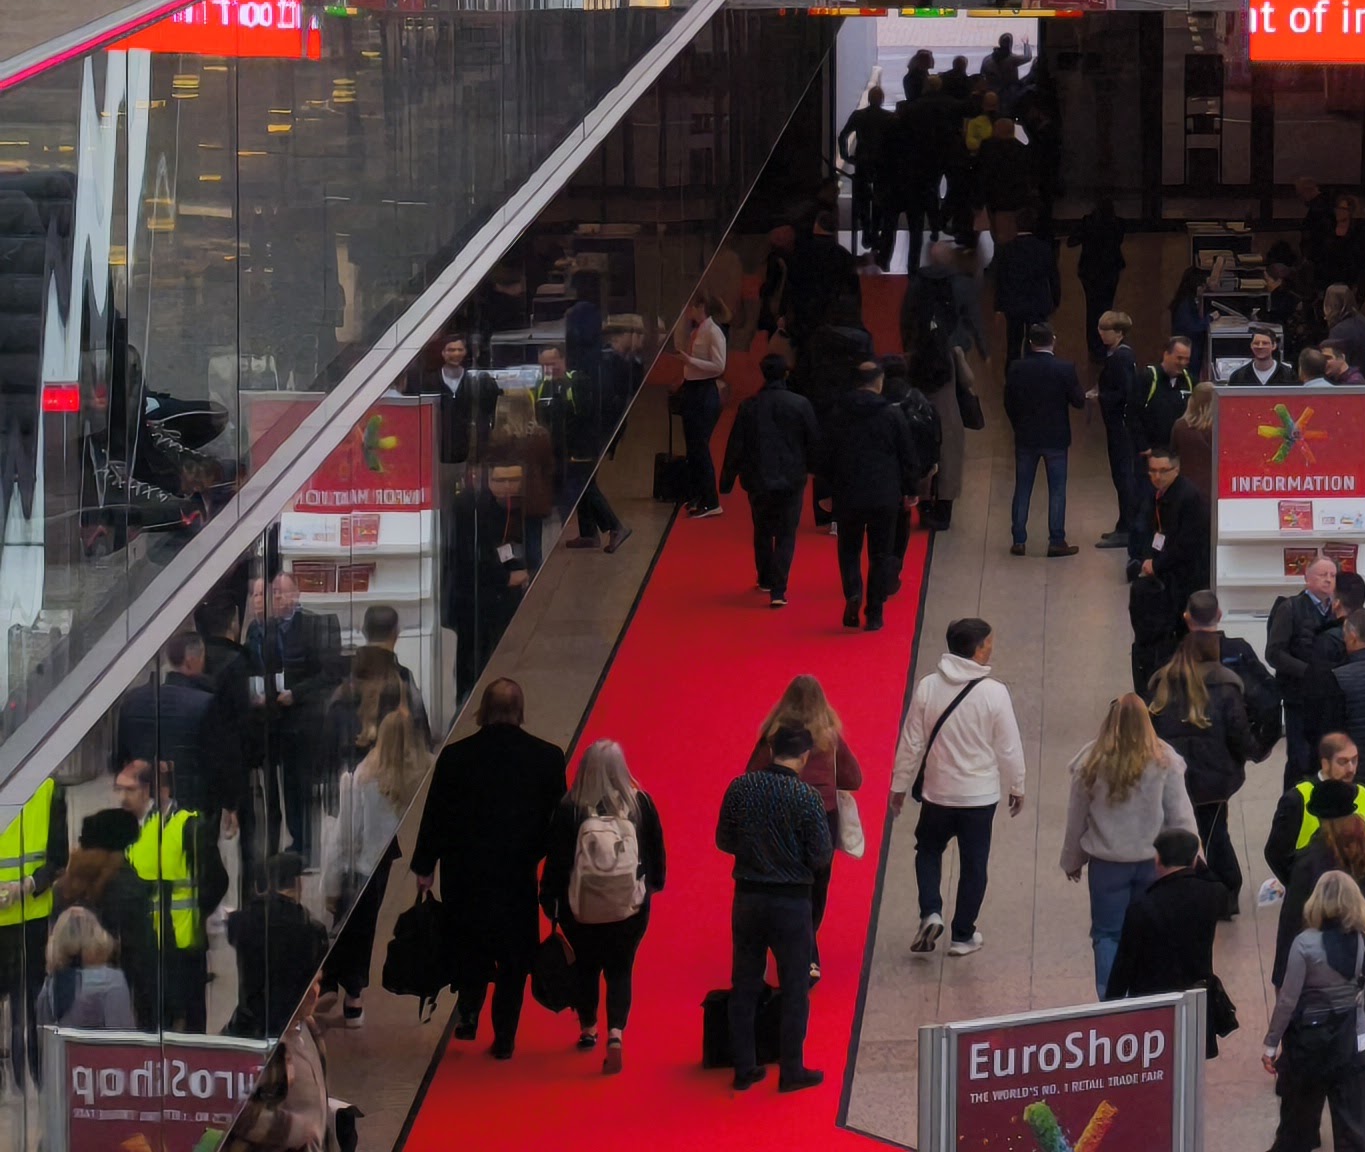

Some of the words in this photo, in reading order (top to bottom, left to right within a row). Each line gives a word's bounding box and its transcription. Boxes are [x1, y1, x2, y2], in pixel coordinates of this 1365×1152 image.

[1289, 0, 1330, 34] of
[1231, 475, 1355, 493] INFORMATION
[969, 1029, 1165, 1080] EuroShop
[970, 1091, 989, 1103] THE
[992, 1085, 1039, 1100] WORLD'S
[1042, 1082, 1060, 1095] NO.
[1071, 1078, 1104, 1091] RETAIL
[1108, 1073, 1138, 1087] TRADE
[1141, 1069, 1164, 1083] FAIR
